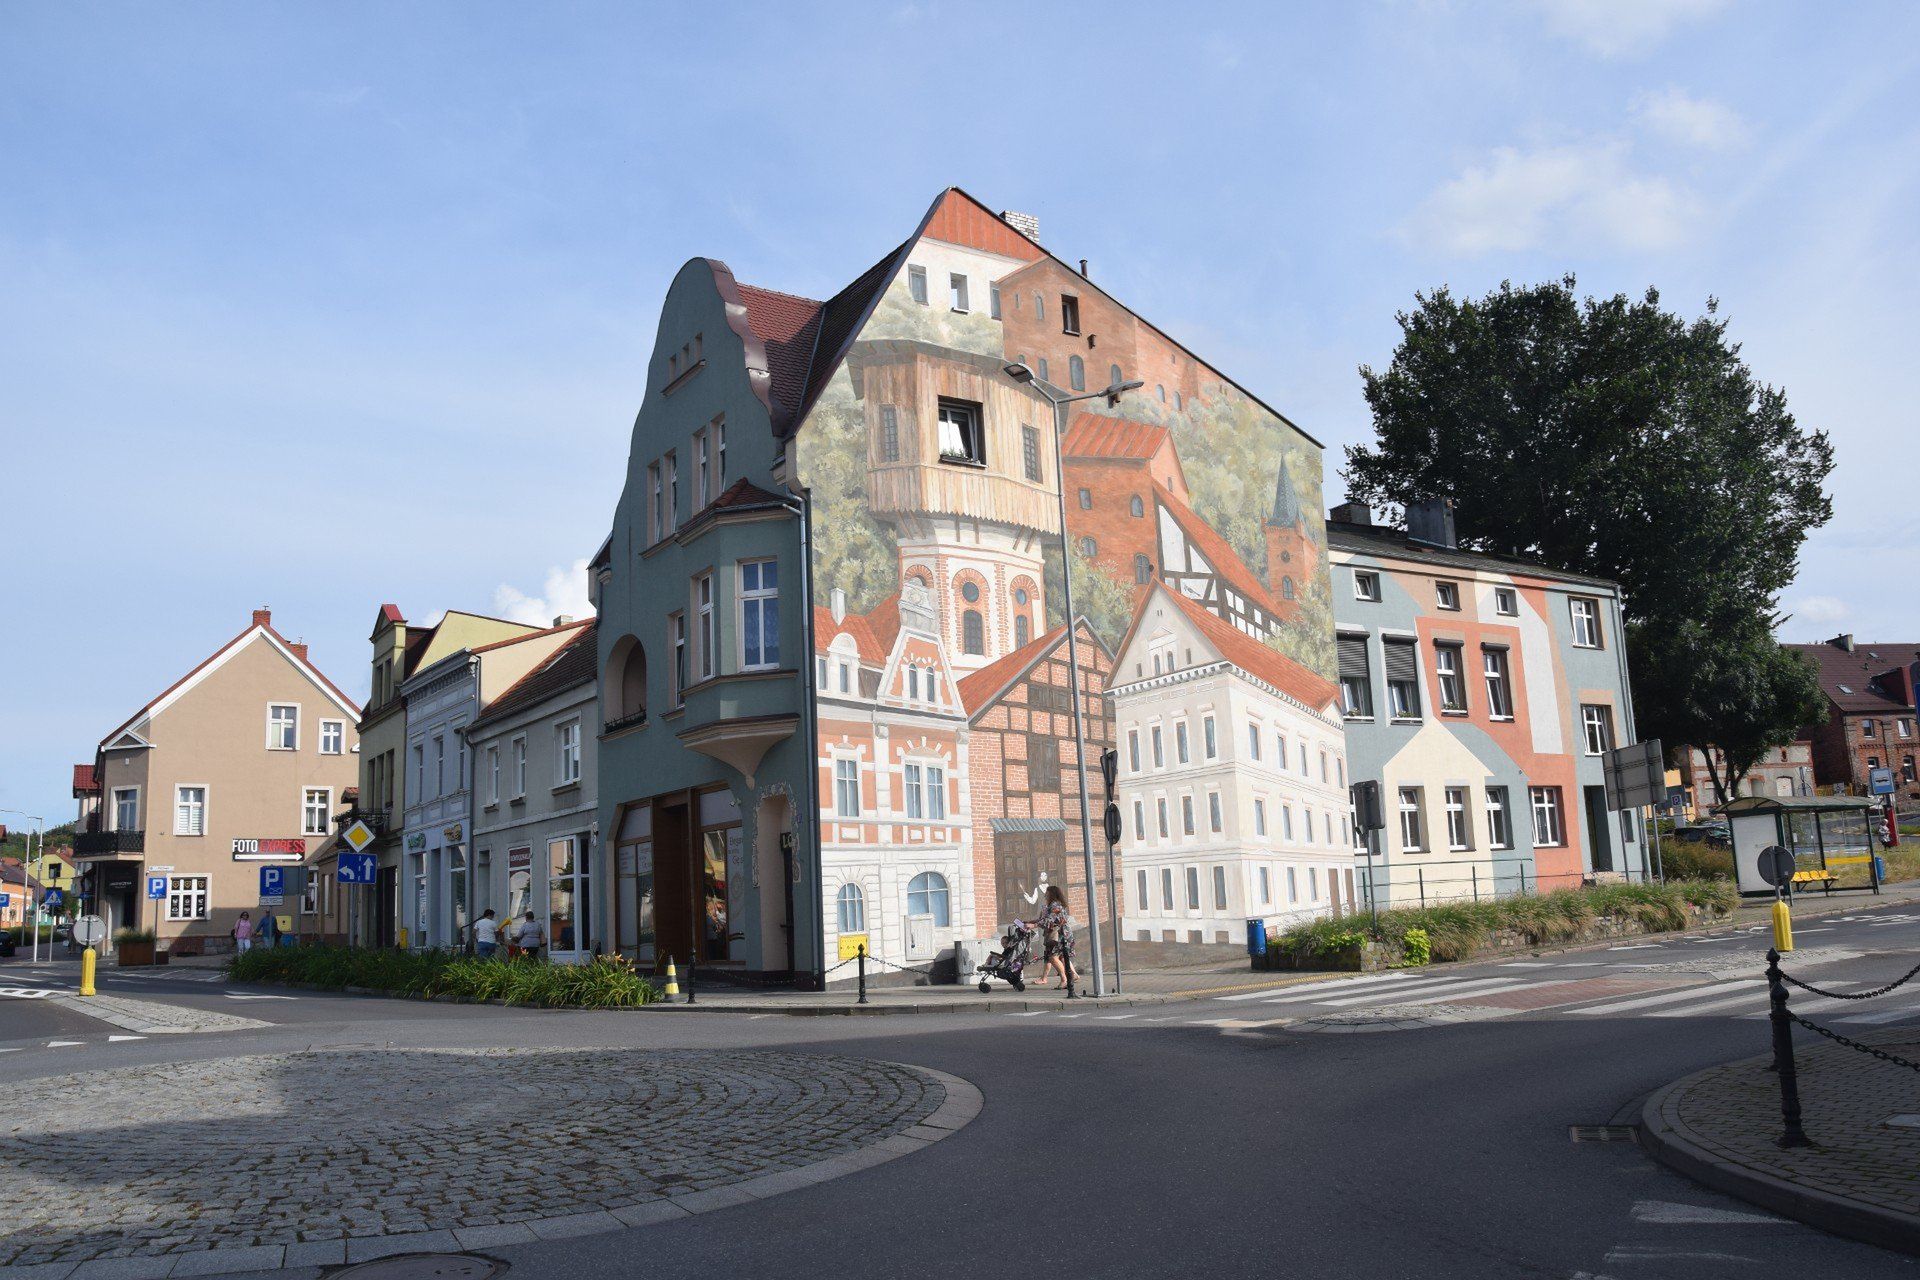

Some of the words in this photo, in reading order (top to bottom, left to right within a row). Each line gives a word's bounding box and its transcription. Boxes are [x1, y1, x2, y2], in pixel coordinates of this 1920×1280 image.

[232, 840, 258, 852] FOTO
[260, 840, 306, 852] EXPRESS
[266, 869, 280, 888] P
[152, 879, 164, 893] P
